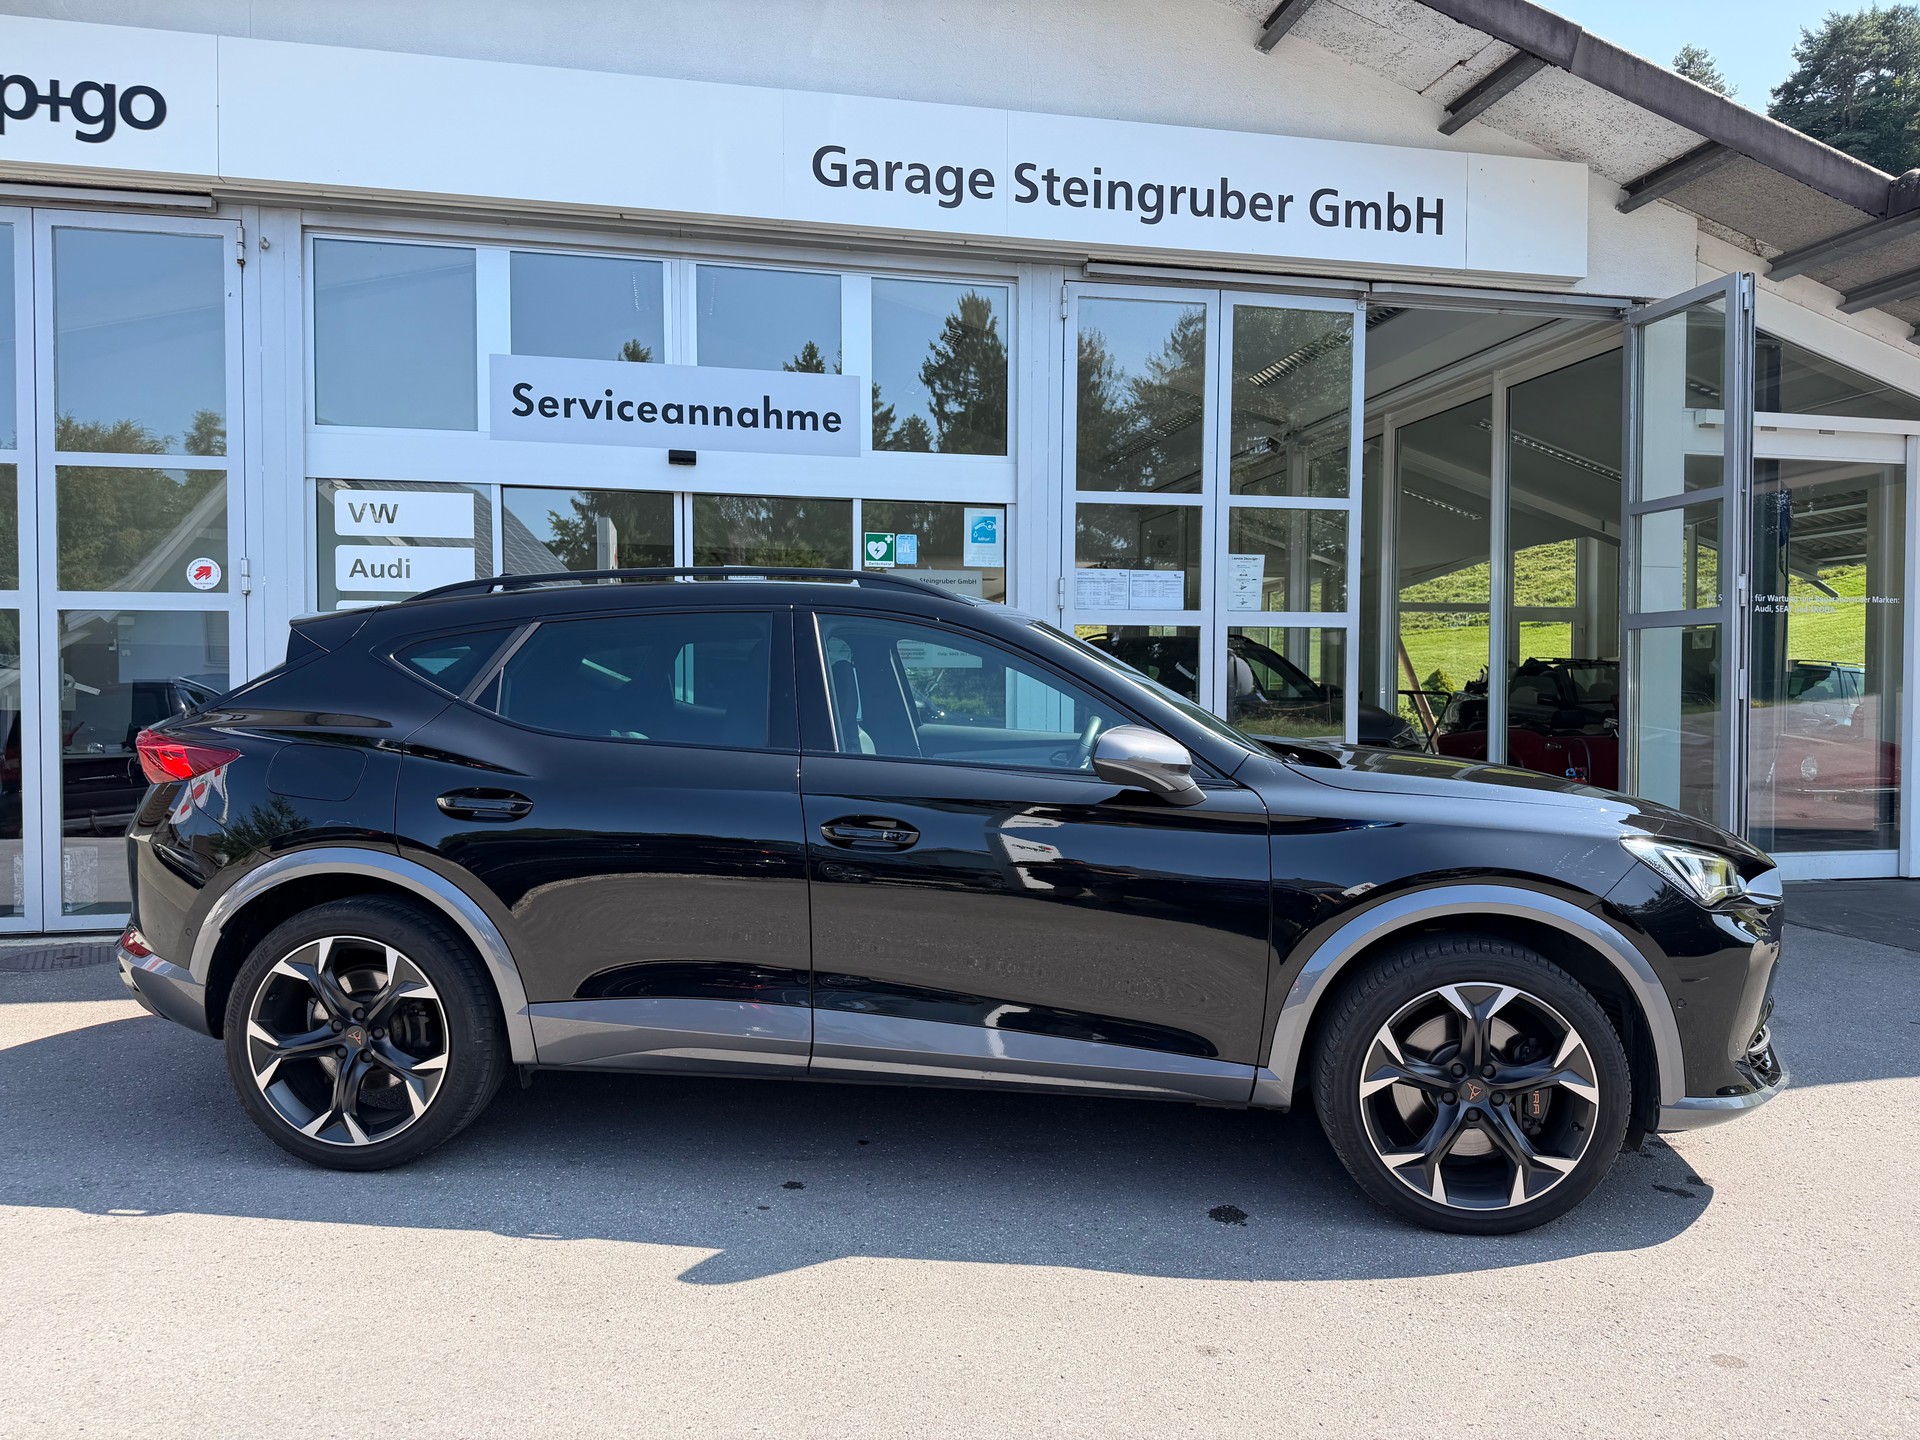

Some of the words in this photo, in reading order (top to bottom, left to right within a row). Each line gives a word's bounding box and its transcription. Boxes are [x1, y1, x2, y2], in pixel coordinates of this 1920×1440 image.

[0, 74, 167, 143] p+go
[812, 145, 995, 208] Garage
[1014, 162, 1294, 225] Steingruber
[1309, 188, 1443, 235] GmbH
[511, 382, 842, 432] Serviceannahme
[348, 503, 399, 524] VW
[349, 558, 411, 579] Audi
[919, 577, 956, 586] Steingruber
[1754, 593, 1765, 602] für
[1767, 594, 1798, 604] Wartung
[1872, 595, 1900, 604] Marken:
[1754, 604, 1774, 613] Audi,
[1775, 604, 1793, 613] SEAT
[228, 945, 271, 1032] BRIDGESTONE
